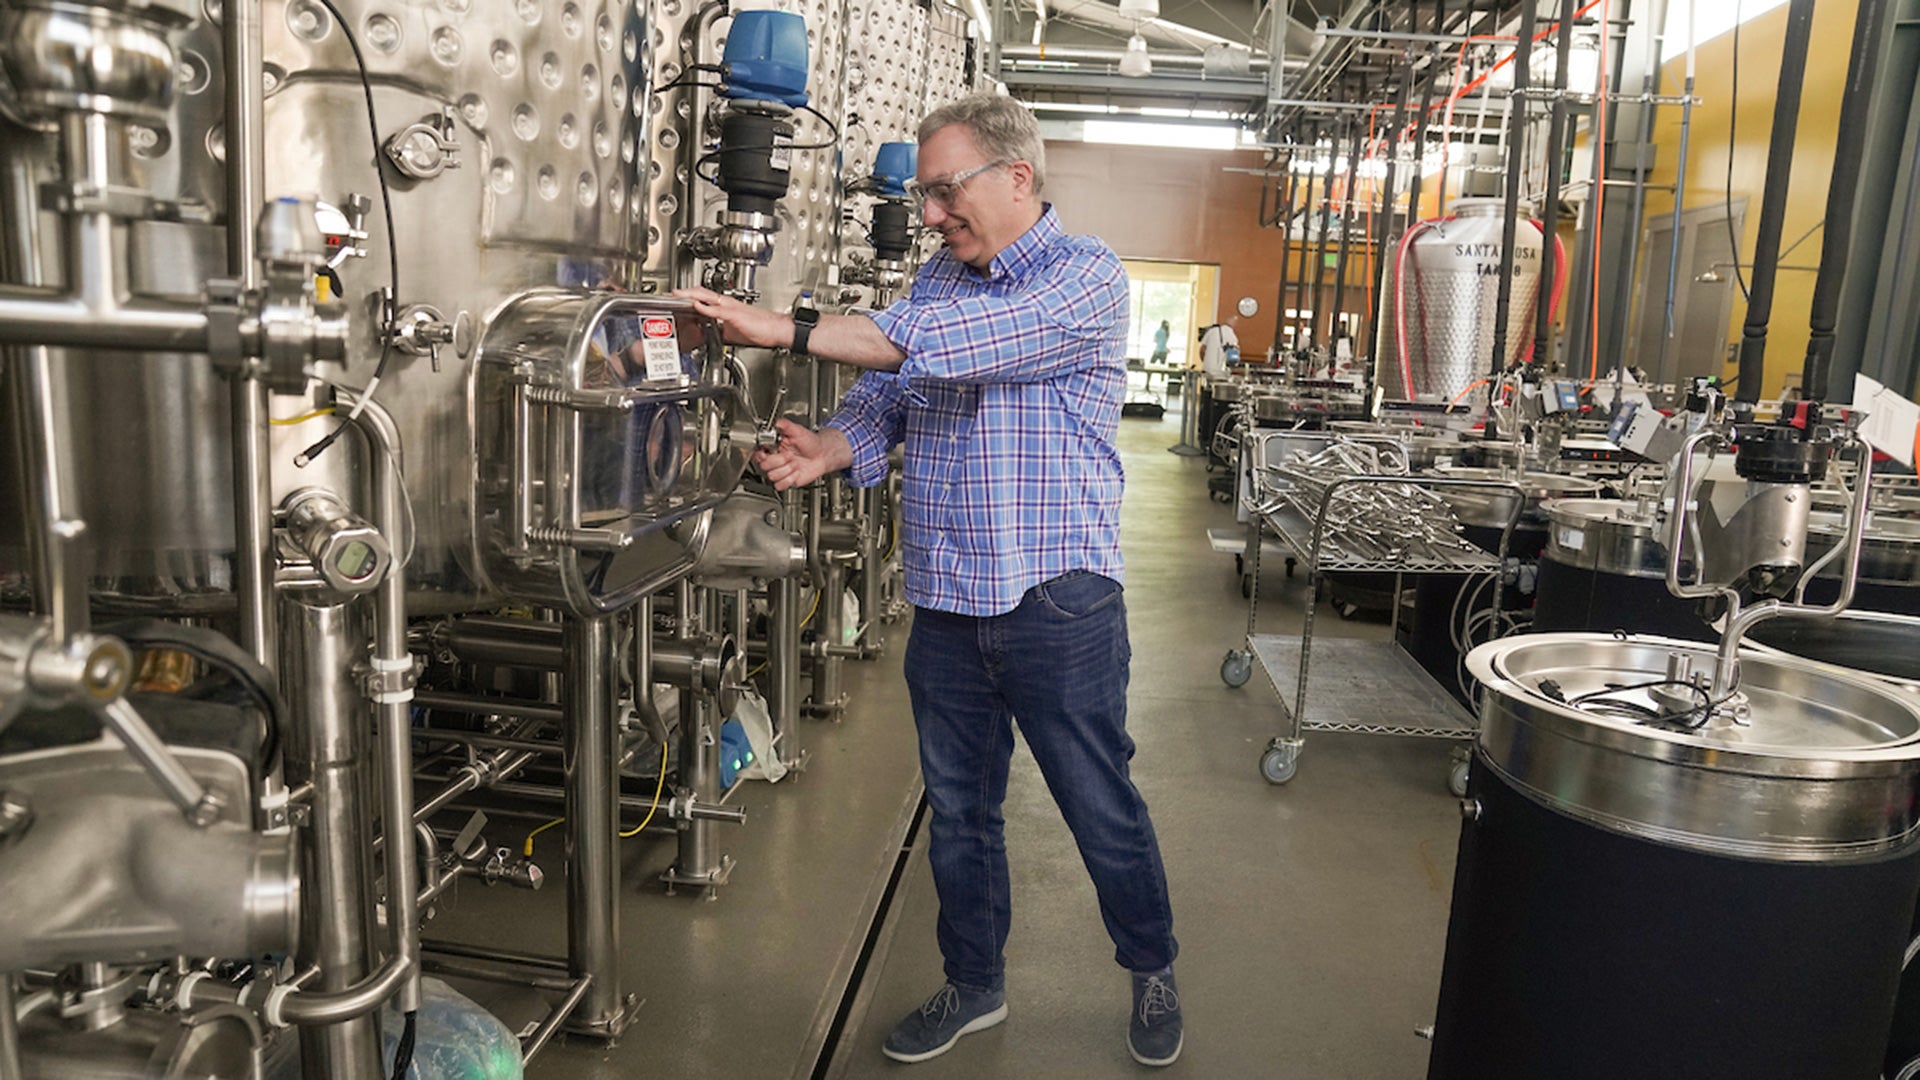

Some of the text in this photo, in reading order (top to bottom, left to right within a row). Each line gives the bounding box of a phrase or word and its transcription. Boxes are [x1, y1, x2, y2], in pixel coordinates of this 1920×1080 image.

[1455, 244, 1536, 260] SANTA OSA
[1477, 263, 1502, 276] TAN
